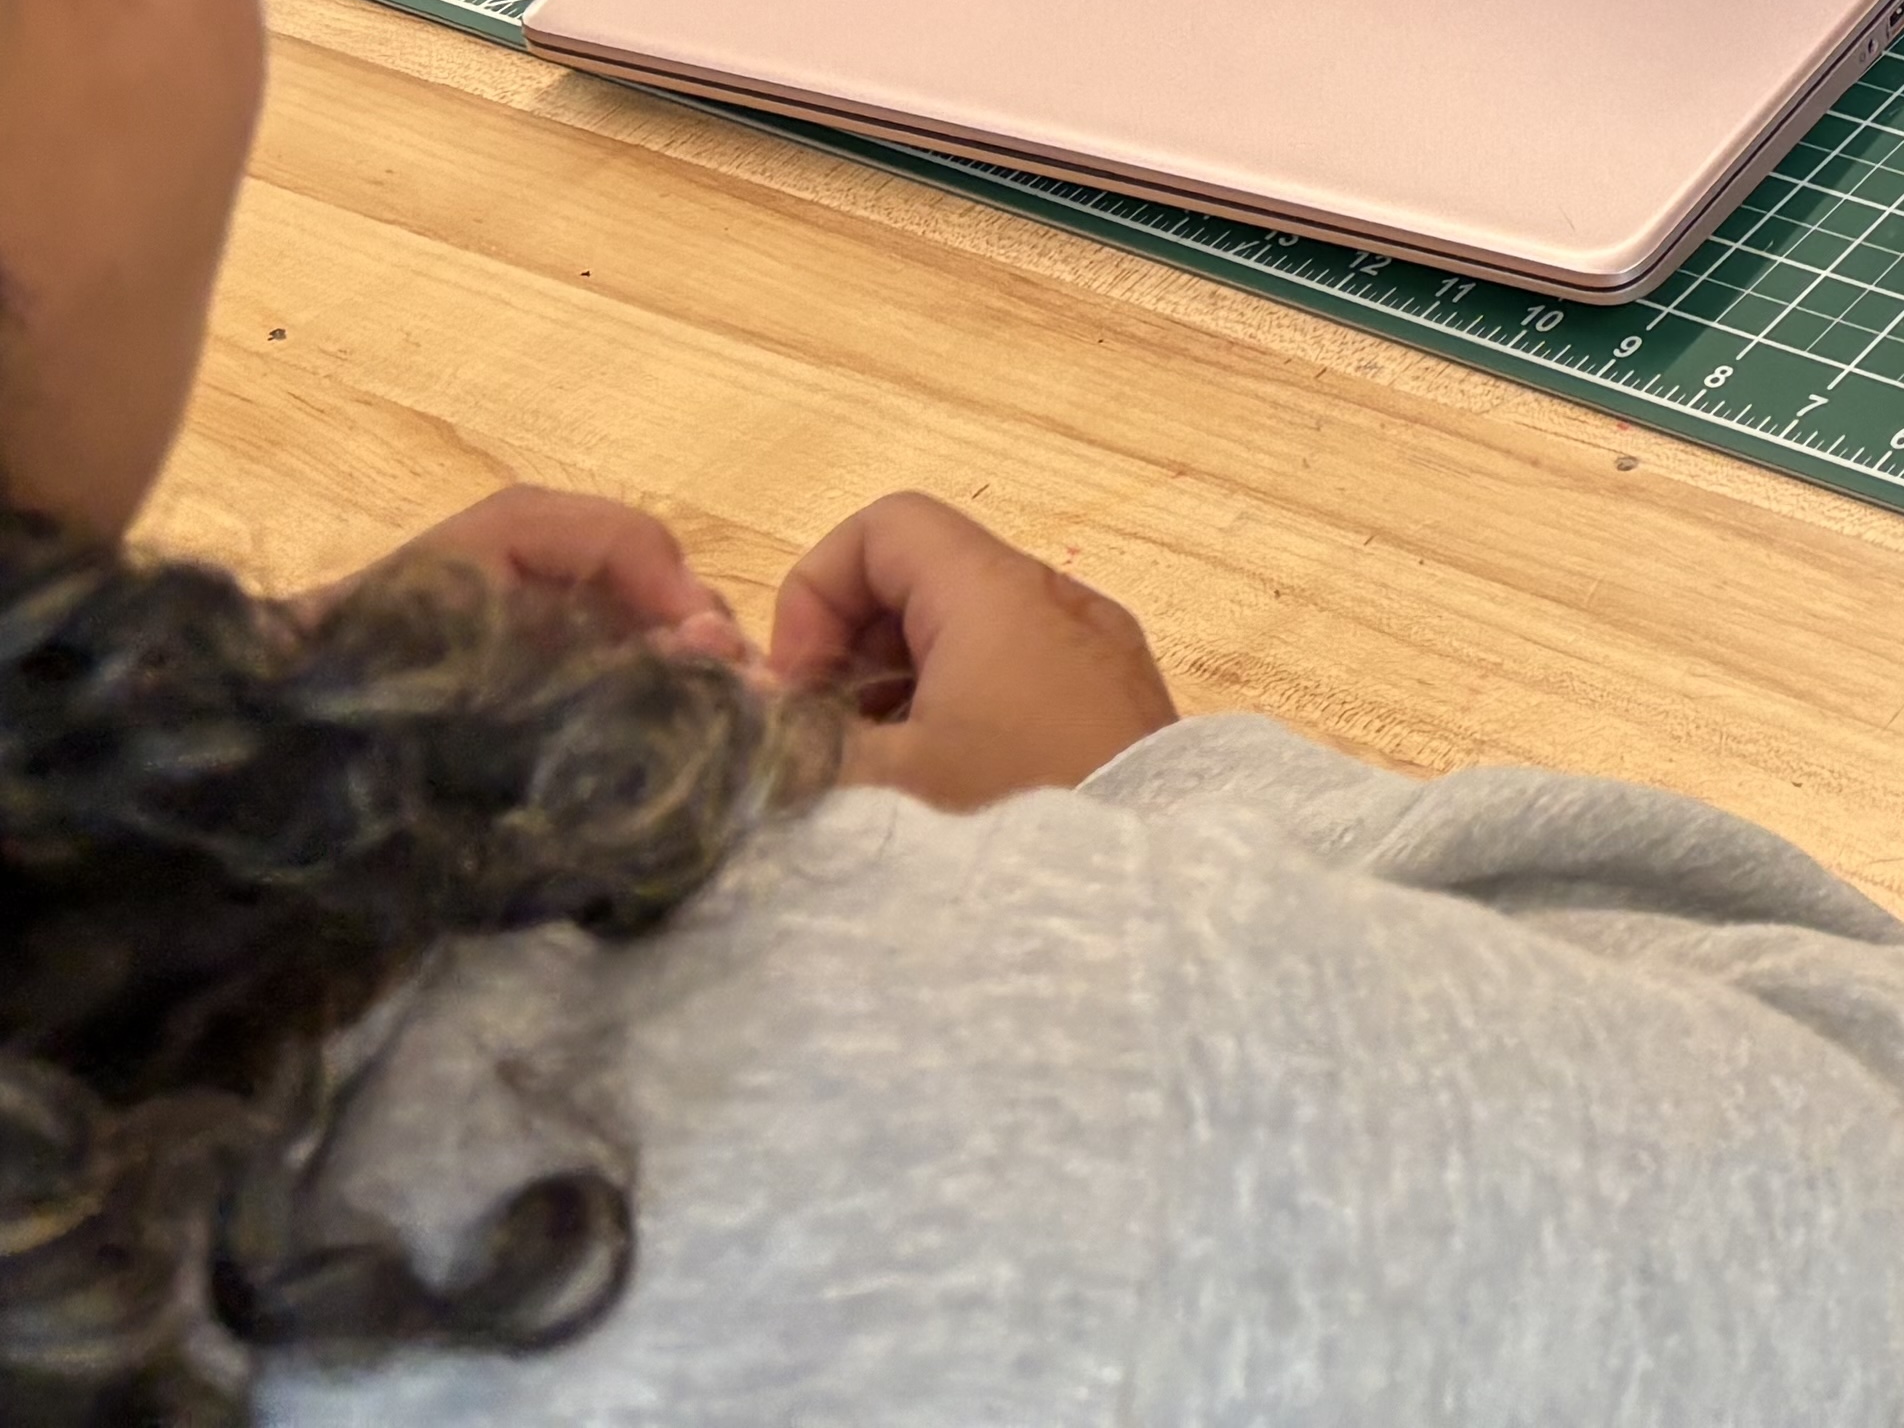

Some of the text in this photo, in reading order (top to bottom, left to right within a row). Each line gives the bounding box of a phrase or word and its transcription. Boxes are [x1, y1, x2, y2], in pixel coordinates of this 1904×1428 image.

[1349, 252, 1392, 276] 12
[1434, 277, 1476, 303] 11
[1520, 305, 1564, 332] 10
[1612, 335, 1643, 358] 9
[1703, 365, 1734, 389] 8
[1796, 393, 1829, 417] 7
